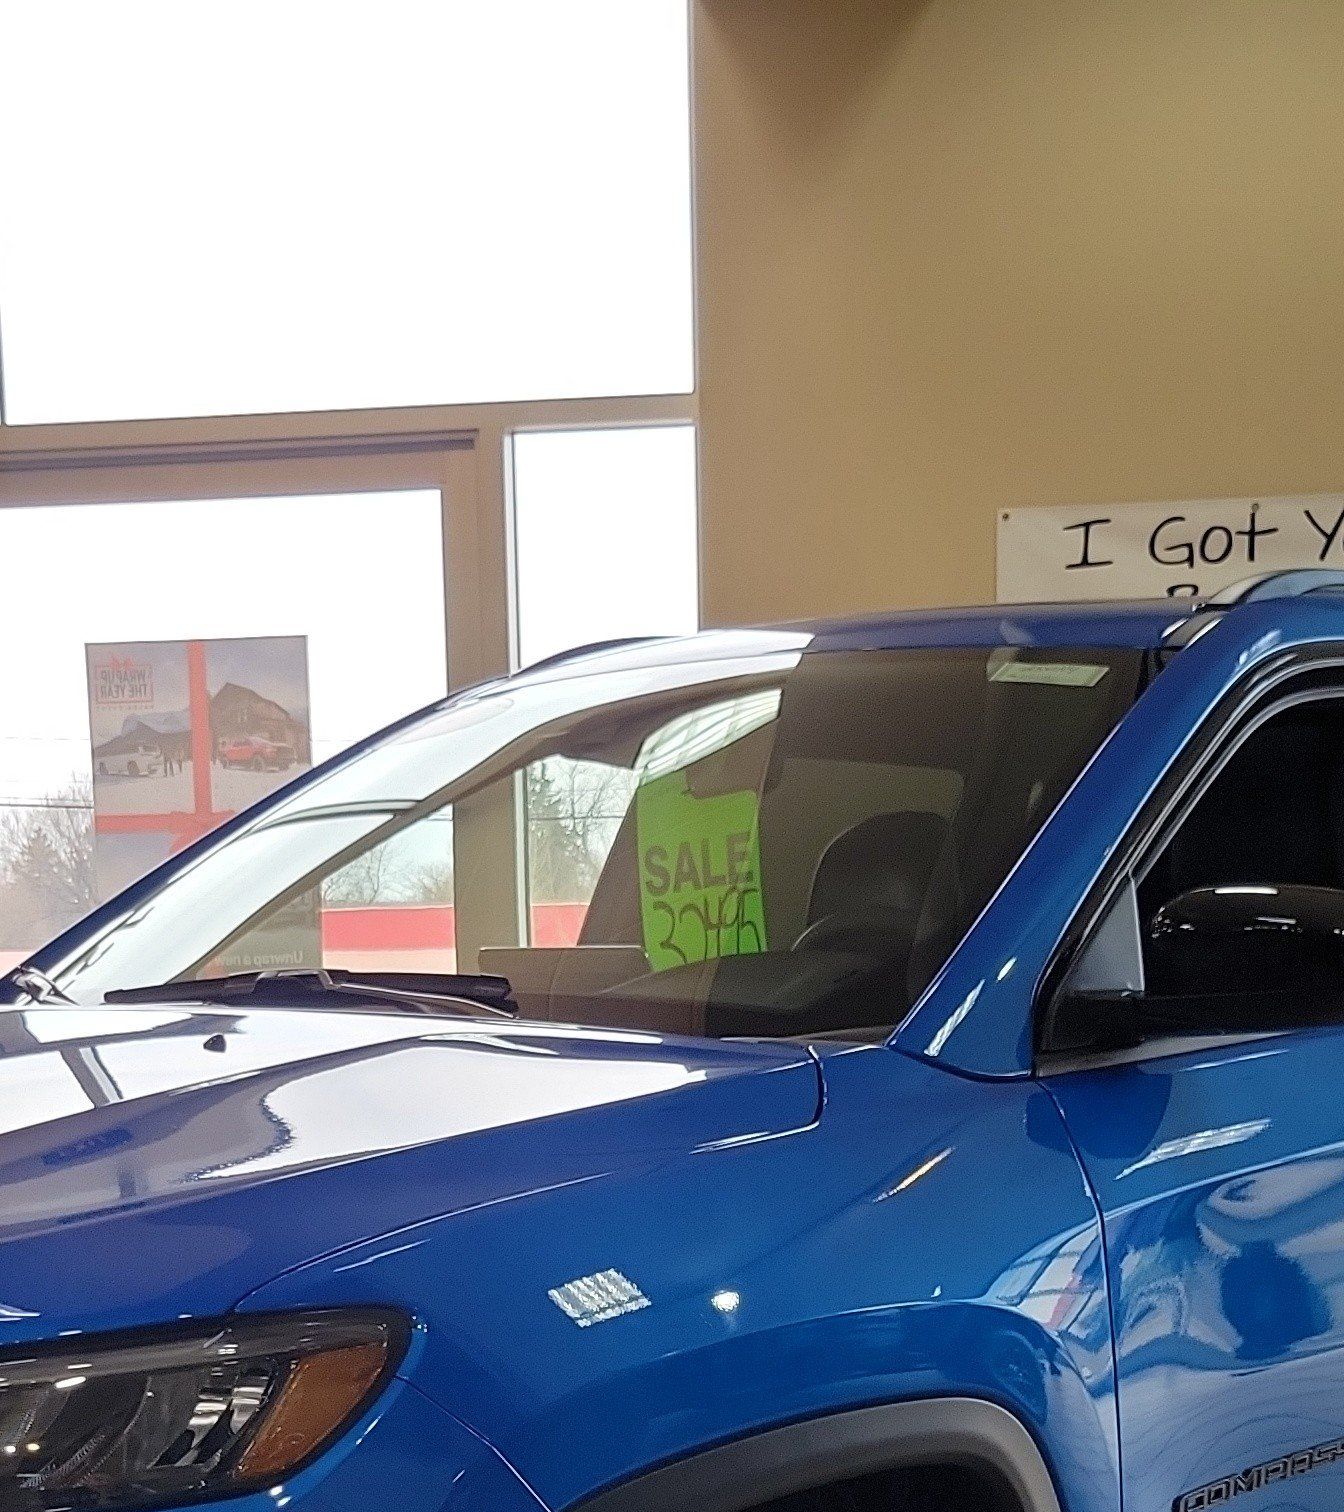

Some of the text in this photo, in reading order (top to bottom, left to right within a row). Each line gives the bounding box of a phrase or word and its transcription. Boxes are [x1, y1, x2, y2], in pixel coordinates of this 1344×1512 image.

[1062, 518, 1114, 570] I
[1147, 511, 1279, 569] Got
[643, 830, 755, 897] SALE
